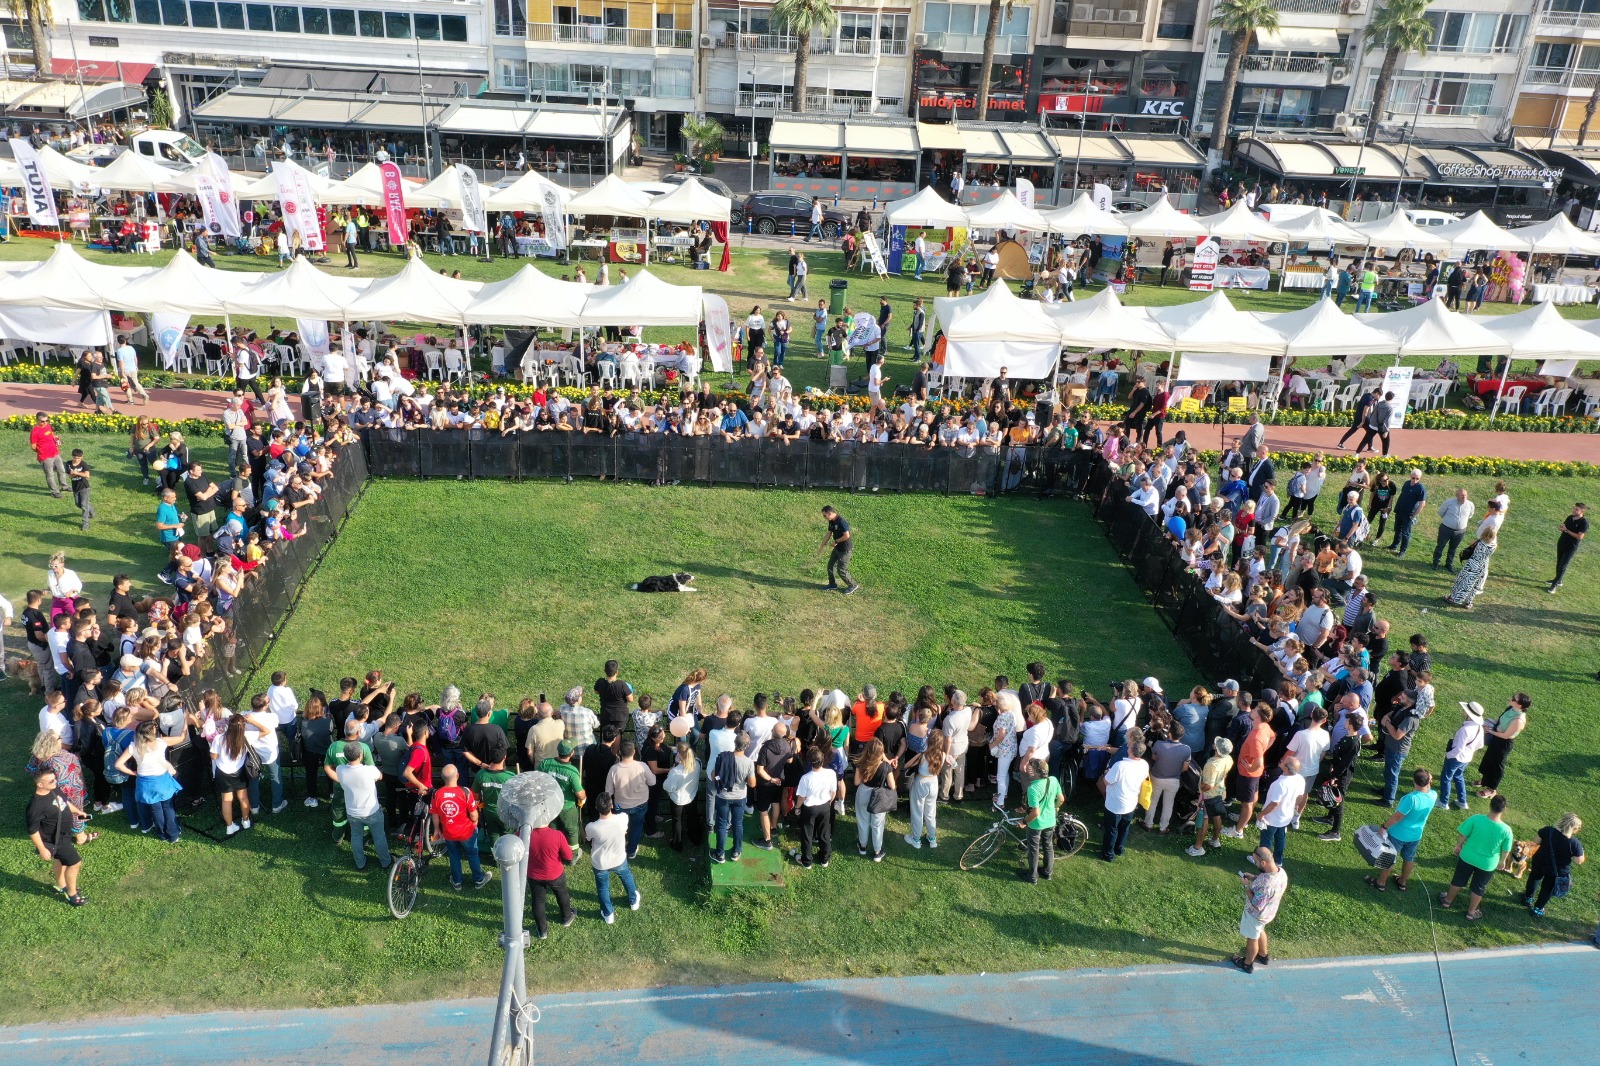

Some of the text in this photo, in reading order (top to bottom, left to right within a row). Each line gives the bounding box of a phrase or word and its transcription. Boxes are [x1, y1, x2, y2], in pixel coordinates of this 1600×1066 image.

[920, 95, 1025, 111] midyeci hmet
[1141, 100, 1185, 118] KFC
